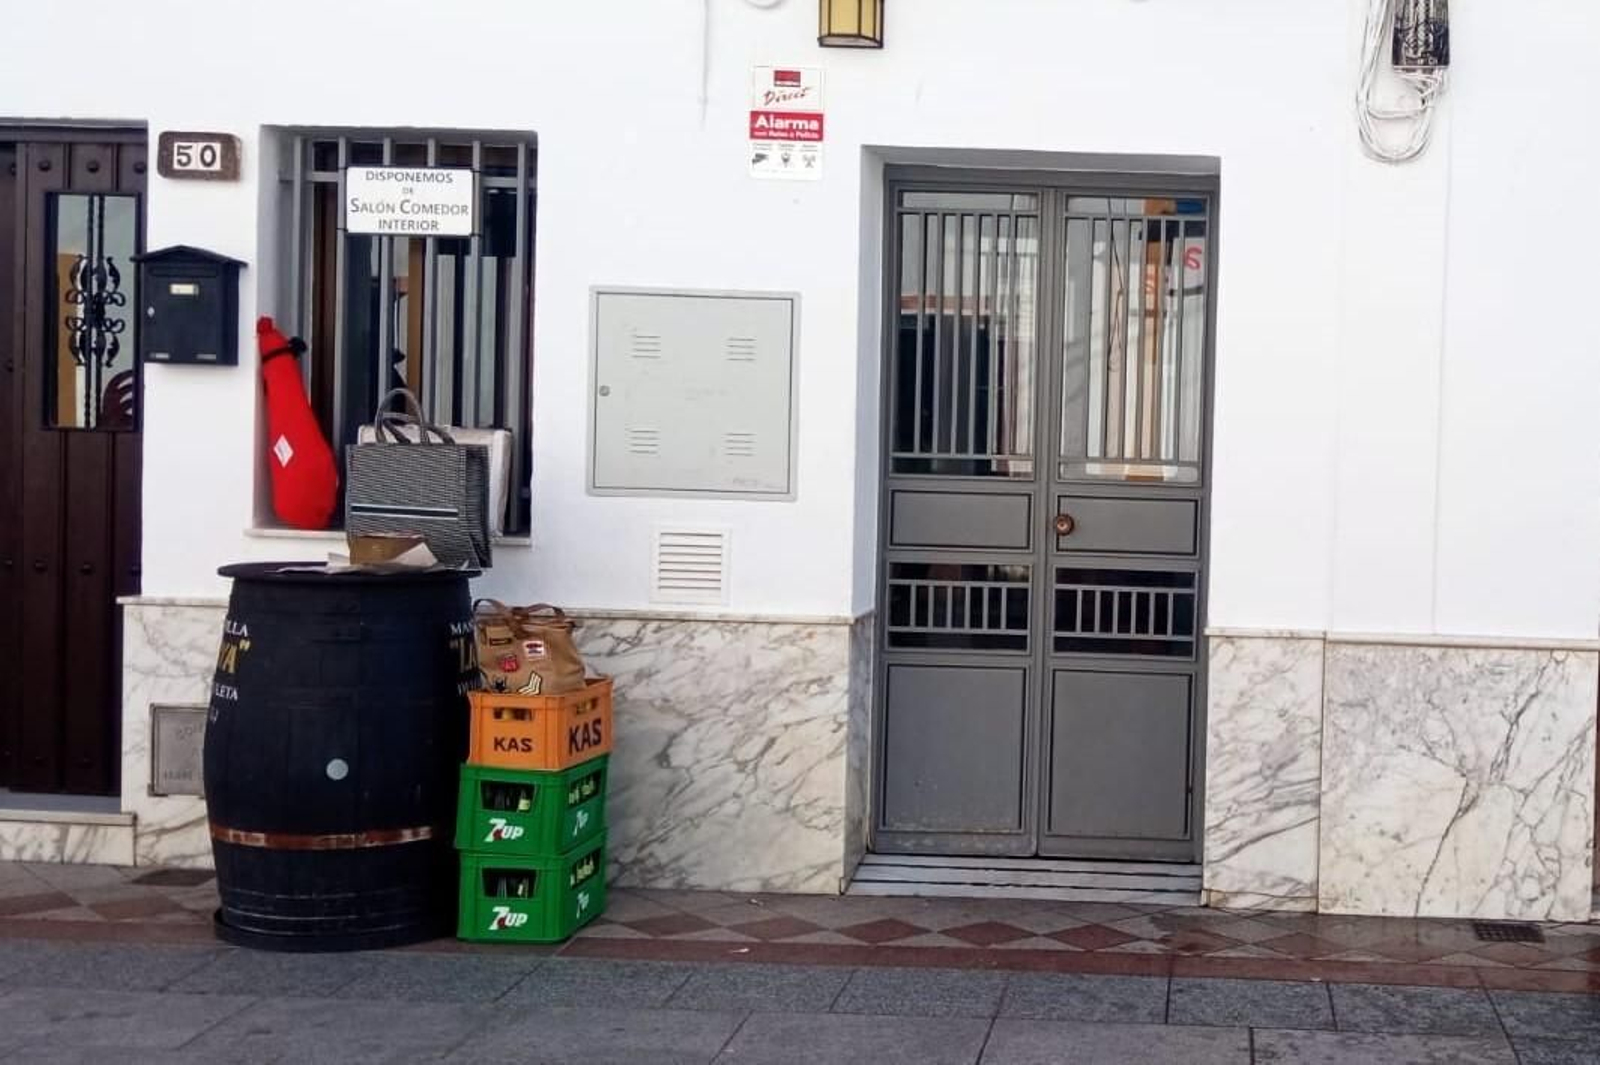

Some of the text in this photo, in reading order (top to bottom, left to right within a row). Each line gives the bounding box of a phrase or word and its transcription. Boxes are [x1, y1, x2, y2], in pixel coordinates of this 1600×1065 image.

[755, 113, 821, 131] Alarma
[176, 145, 217, 168] 50
[365, 170, 454, 184] DISPONEMOS
[402, 187, 414, 195] DE
[400, 199, 470, 216] COMEDOR
[378, 219, 440, 232] INTERIOR
[493, 736, 534, 753] KAS
[567, 717, 603, 757] KAS
[484, 817, 525, 842] 7UP
[488, 906, 529, 931] 7UP
